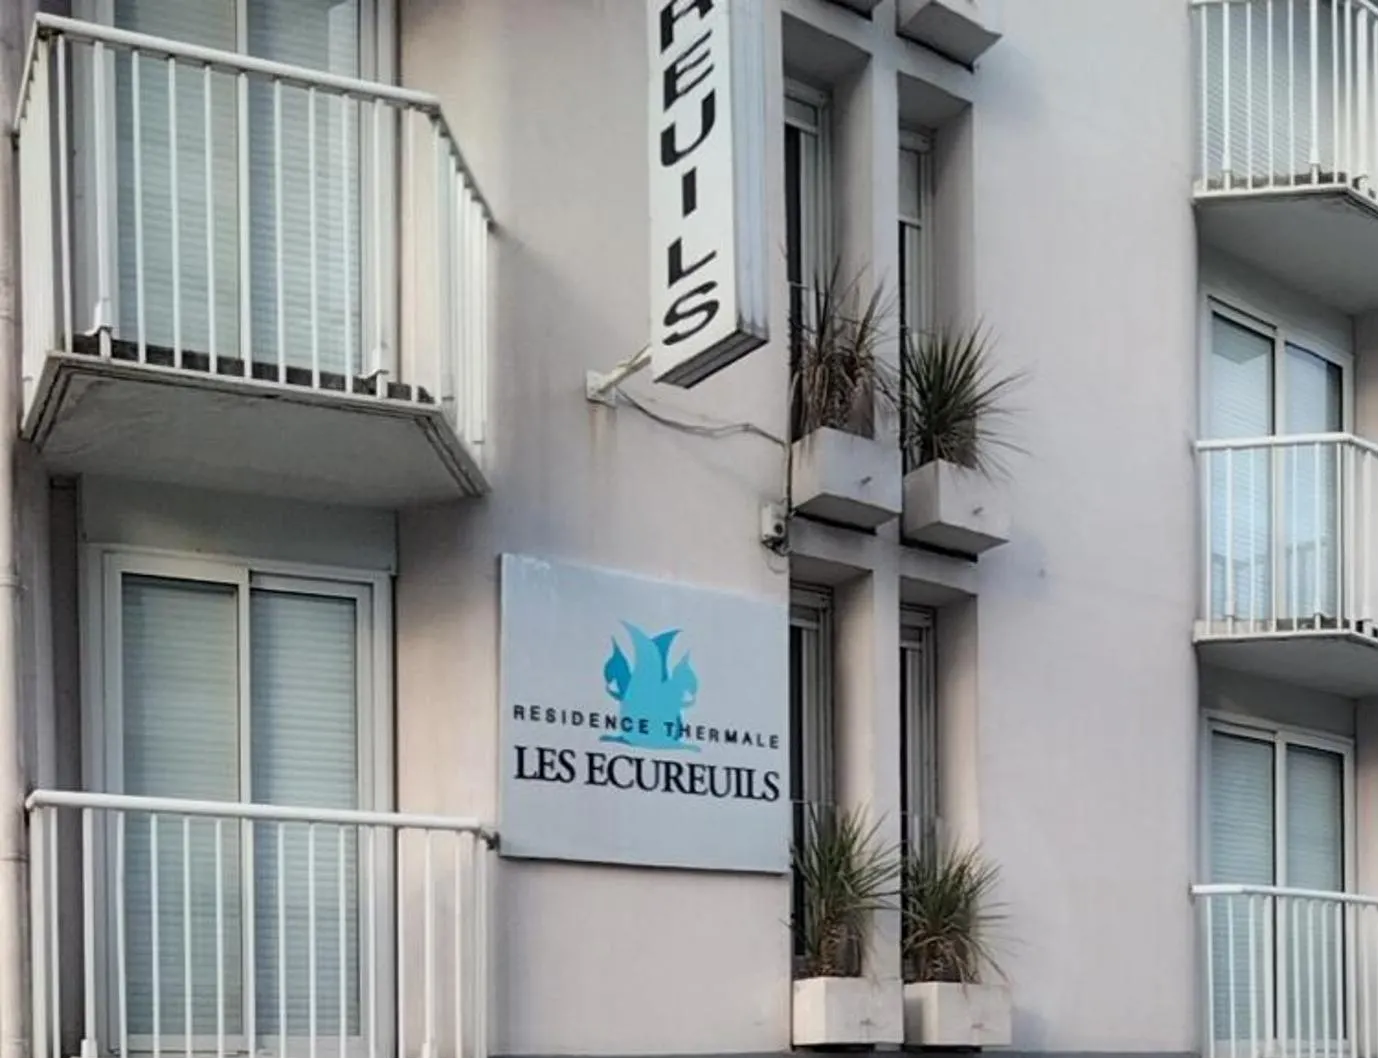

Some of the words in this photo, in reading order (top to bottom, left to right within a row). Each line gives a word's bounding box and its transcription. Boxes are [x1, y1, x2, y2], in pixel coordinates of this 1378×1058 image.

[513, 704, 649, 734] RESIDENCE
[664, 717, 779, 750] THERMALE
[513, 746, 576, 784] LES
[585, 752, 780, 802] ECUREUILS
